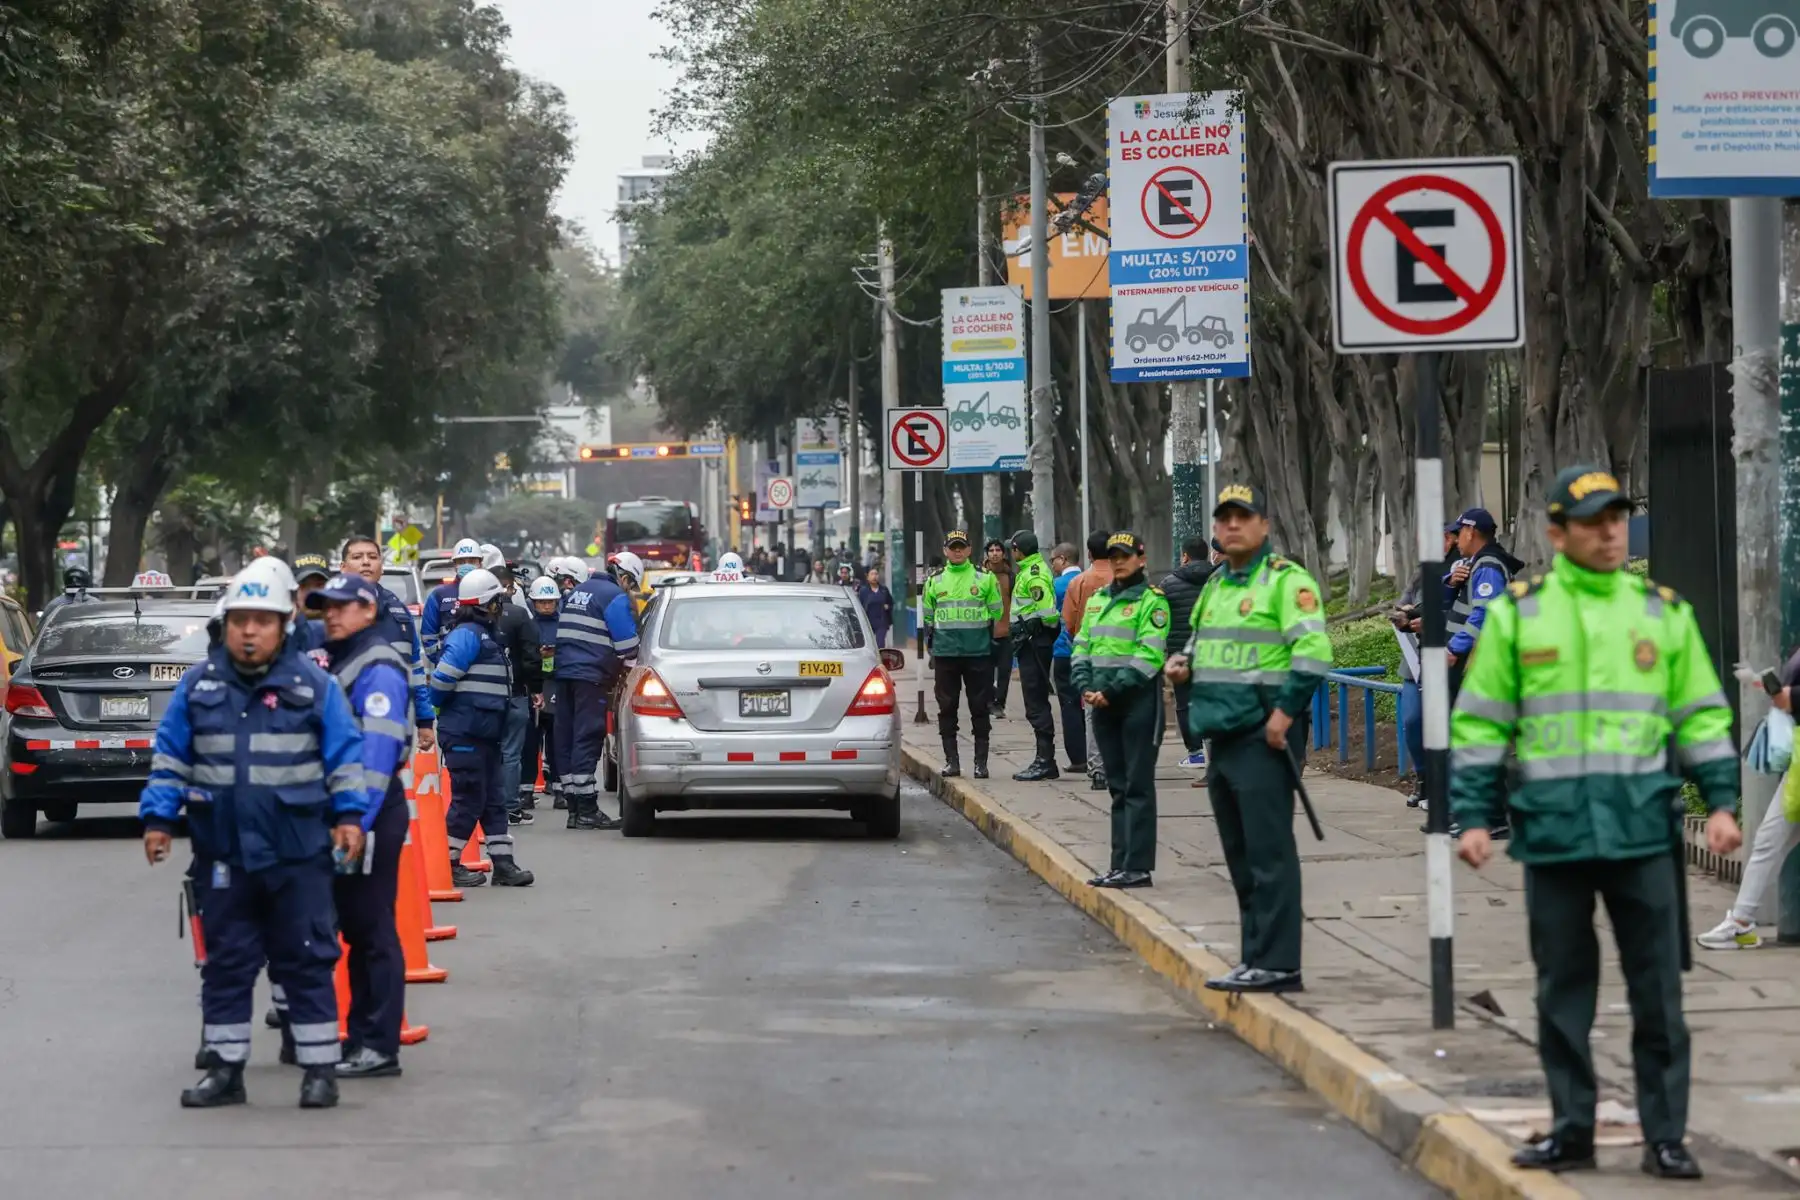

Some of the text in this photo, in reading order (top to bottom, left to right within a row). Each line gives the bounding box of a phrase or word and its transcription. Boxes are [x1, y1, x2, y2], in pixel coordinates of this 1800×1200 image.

[1704, 90, 1800, 100] AVISO PREVENTI
[1672, 105, 1704, 113] Multa
[1705, 106, 1723, 115] por
[1120, 124, 1231, 144] LA CALLE NO
[1121, 142, 1230, 161] ES COCHERA
[1158, 179, 1194, 226] E
[1121, 248, 1237, 268] MULTA: S/1070
[1395, 208, 1458, 304] E
[1149, 265, 1209, 280] (20% UIT)
[1117, 285, 1184, 297] INTERNAMIENTO
[1198, 282, 1239, 292] VEHÍCULO
[952, 312, 1014, 324] LA CALLE NO
[952, 324, 1013, 334] ES COCHERA
[1133, 355, 1176, 364] Ordenanza
[908, 423, 929, 456] E
[773, 486, 788, 498] 50
[458, 546, 473, 554] ATU
[138, 575, 167, 586] TAXI
[713, 573, 739, 581] TAXI
[235, 582, 270, 597] ATU
[540, 586, 554, 594] ATU
[568, 590, 593, 605] ATU
